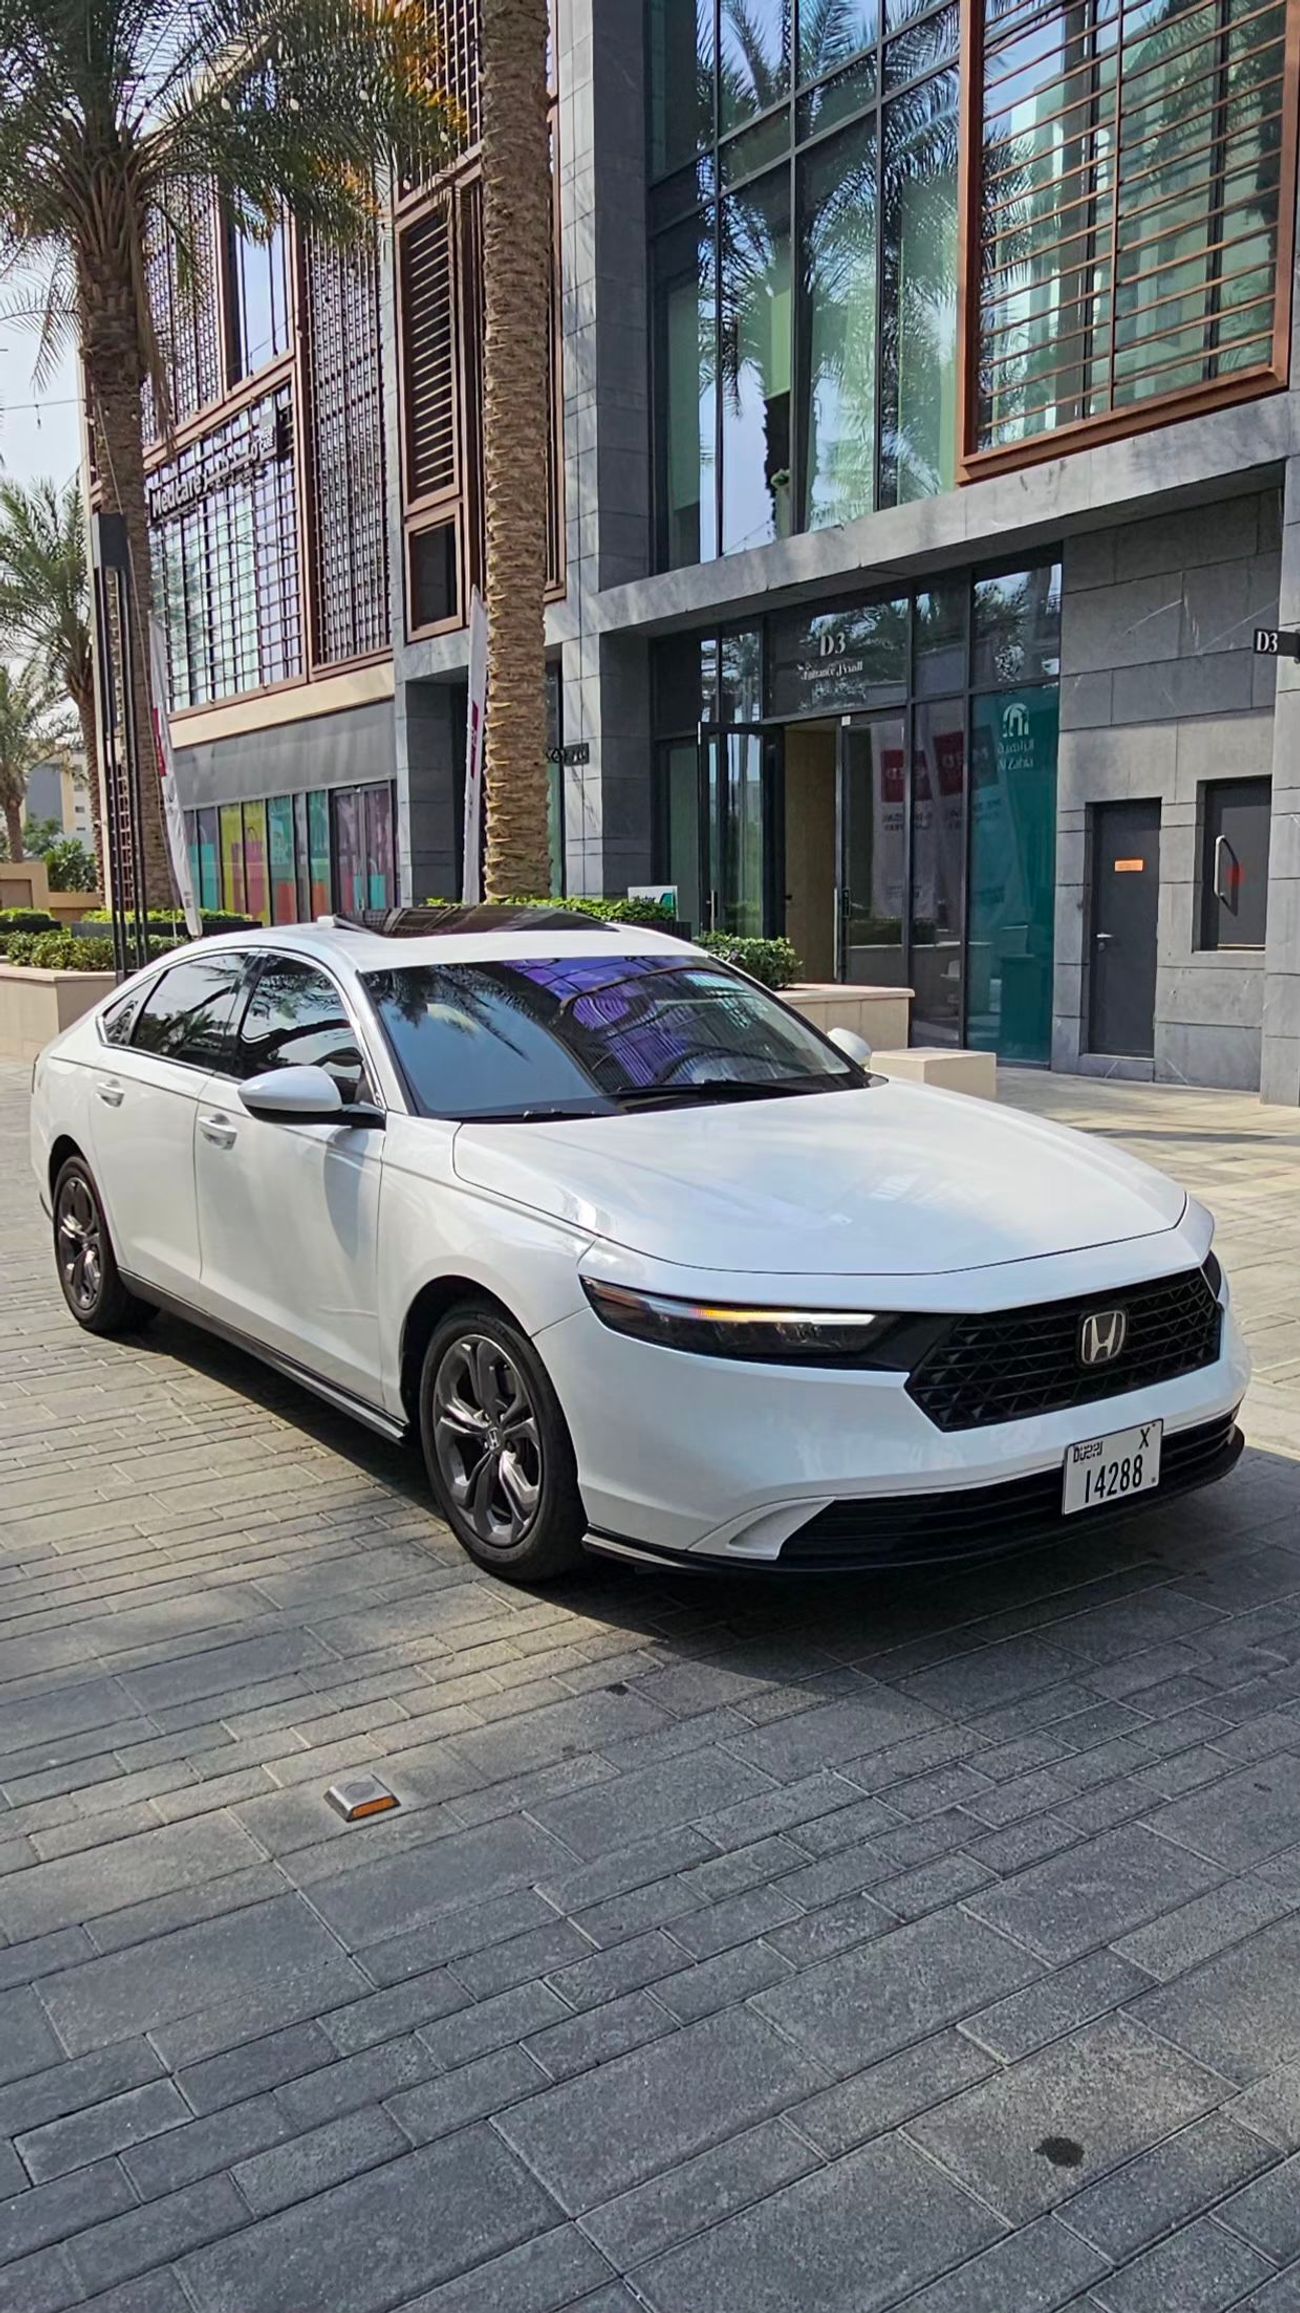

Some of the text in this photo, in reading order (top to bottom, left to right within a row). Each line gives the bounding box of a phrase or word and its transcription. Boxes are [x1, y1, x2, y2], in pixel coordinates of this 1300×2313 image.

[820, 631, 846, 656] D3
[1256, 631, 1278, 653] D3
[1138, 1426, 1151, 1450] X
[1084, 1453, 1143, 1503] 14288
